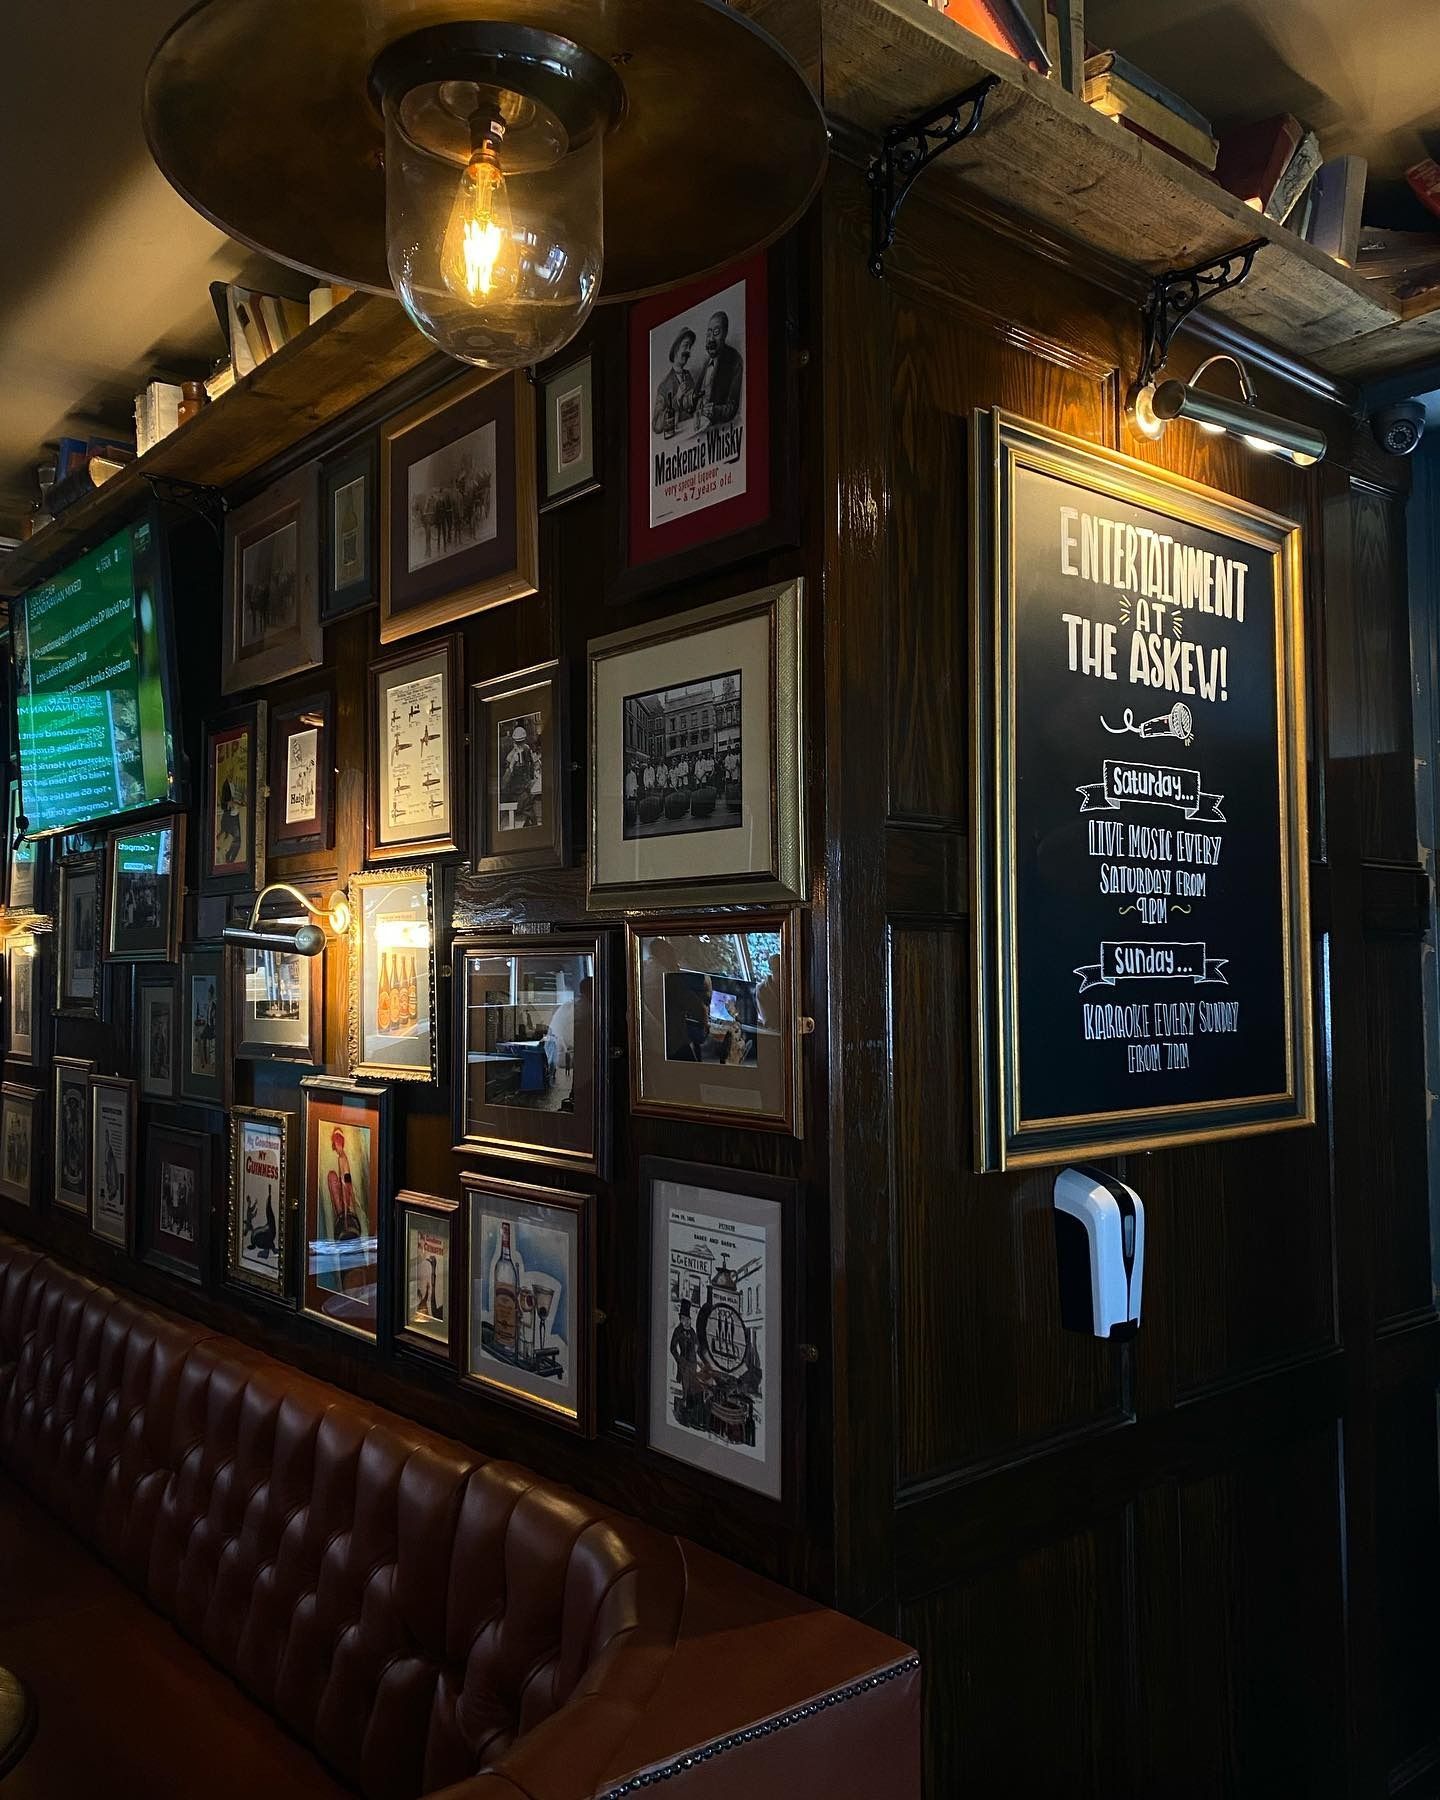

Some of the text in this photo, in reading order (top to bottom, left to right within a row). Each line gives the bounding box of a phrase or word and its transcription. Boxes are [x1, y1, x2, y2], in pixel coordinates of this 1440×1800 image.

[655, 423, 744, 487] Mackenzie Whisky
[664, 483, 678, 497] very
[689, 487, 696, 500] 7
[695, 481, 717, 502] years
[1060, 506, 1248, 623] ENTERTAINMENT
[30, 579, 82, 621] SCANDINAVIAN MIXED
[98, 610, 106, 623] DP
[106, 602, 119, 620] World
[119, 598, 130, 611] Tour
[1136, 598, 1166, 636] AT
[58, 657, 77, 673] European
[77, 651, 88, 662] Tour
[1061, 613, 1228, 702] THE ASKEW!
[90, 669, 105, 685] Annika
[290, 793, 304, 808] Haig
[1088, 819, 1222, 866] LIVE MUSIC EVERY
[1099, 863, 1206, 898] SATURDAY FROM
[1136, 896, 1168, 925] 9PM
[1083, 1000, 1239, 1041] KARAOKE EVERY SUNDAY
[1127, 1042, 1190, 1073] FROM 7PM
[246, 1156, 279, 1180] GUINNESS
